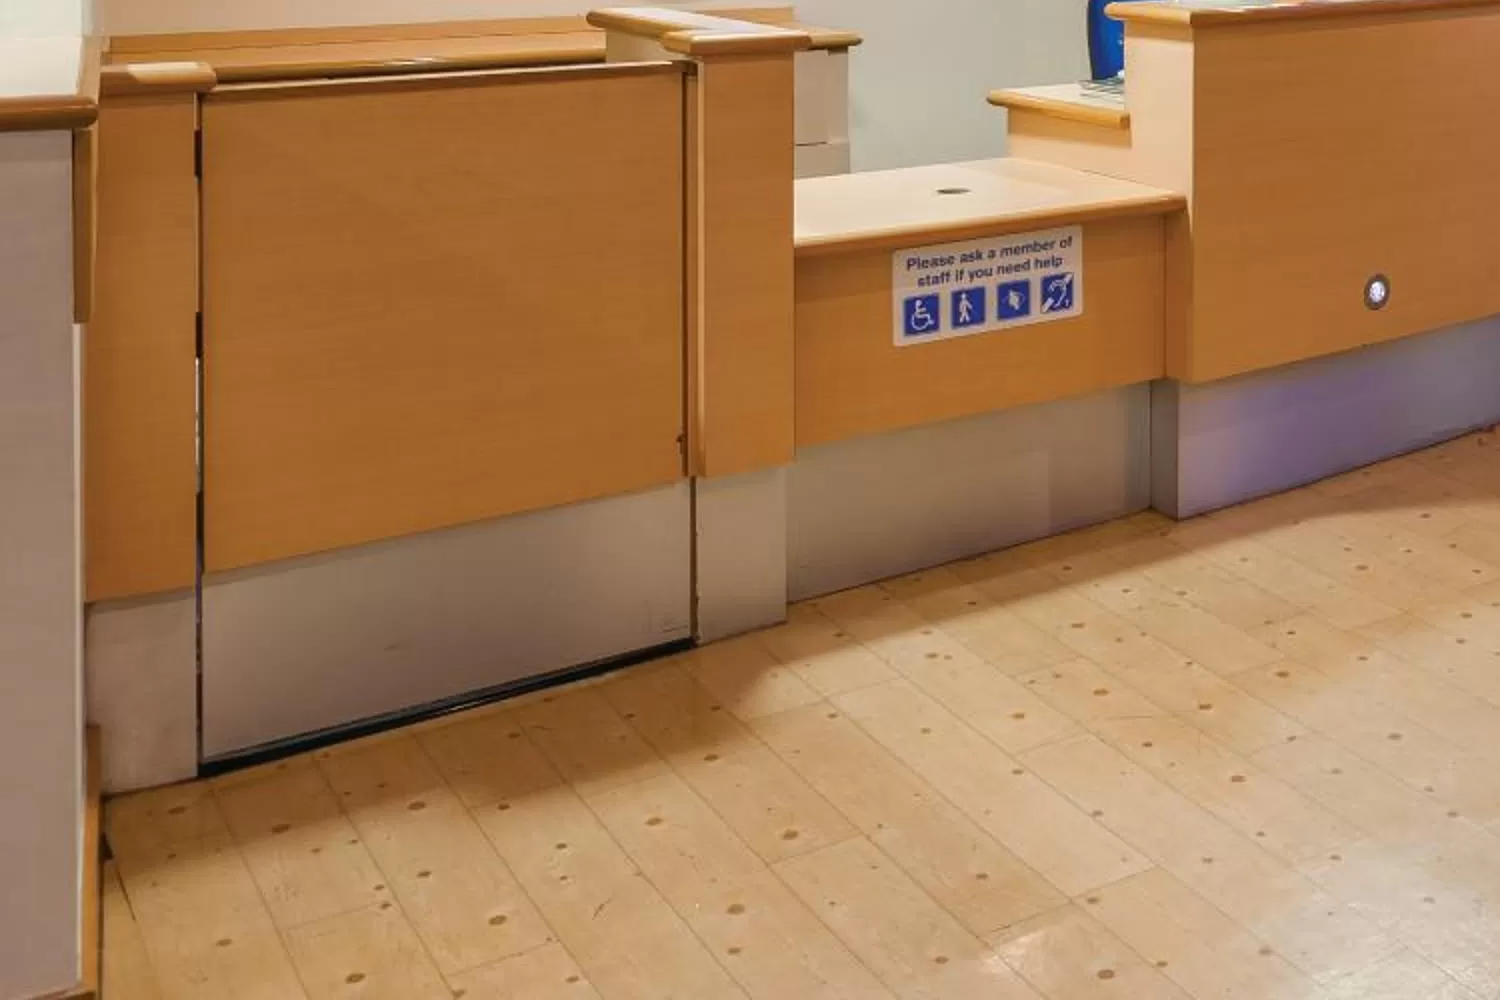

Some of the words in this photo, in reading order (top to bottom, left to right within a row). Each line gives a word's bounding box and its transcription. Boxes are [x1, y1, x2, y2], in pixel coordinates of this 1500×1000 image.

[907, 255, 955, 270] Please
[960, 249, 984, 264] ask
[987, 248, 996, 259] a
[1000, 239, 1056, 256] member
[1059, 236, 1073, 248] of
[917, 272, 951, 287] staff
[955, 268, 964, 282] if
[968, 268, 993, 282] you
[997, 259, 1031, 274] need
[1033, 255, 1063, 270] help
